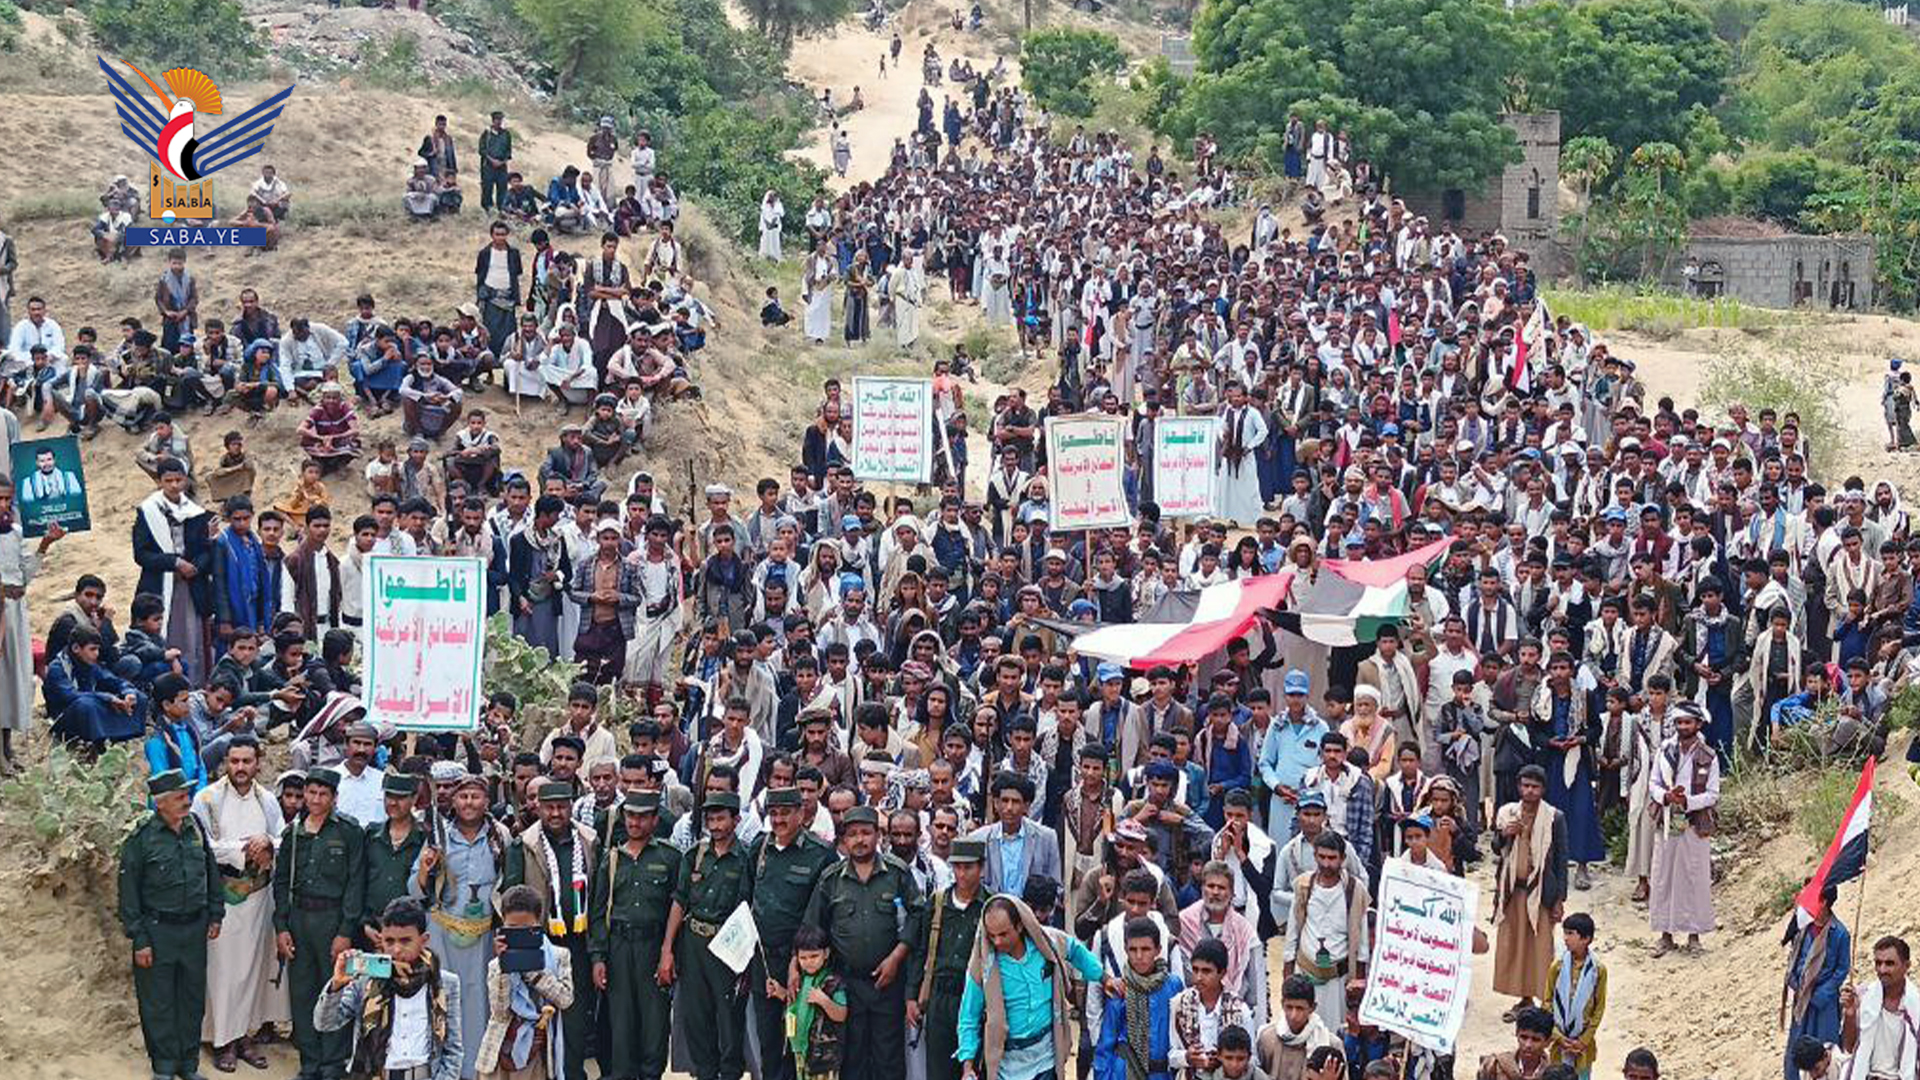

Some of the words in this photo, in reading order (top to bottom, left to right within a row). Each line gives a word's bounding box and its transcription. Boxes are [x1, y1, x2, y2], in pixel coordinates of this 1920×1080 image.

[898, 386, 921, 403] الله
[378, 567, 467, 608] قاطعوا
[1389, 892, 1444, 918] أكبر
[1438, 901, 1462, 926] الله
[1420, 930, 1460, 952] الموت
[1416, 956, 1456, 979] الموت
[1422, 982, 1453, 1003] اللعنة
